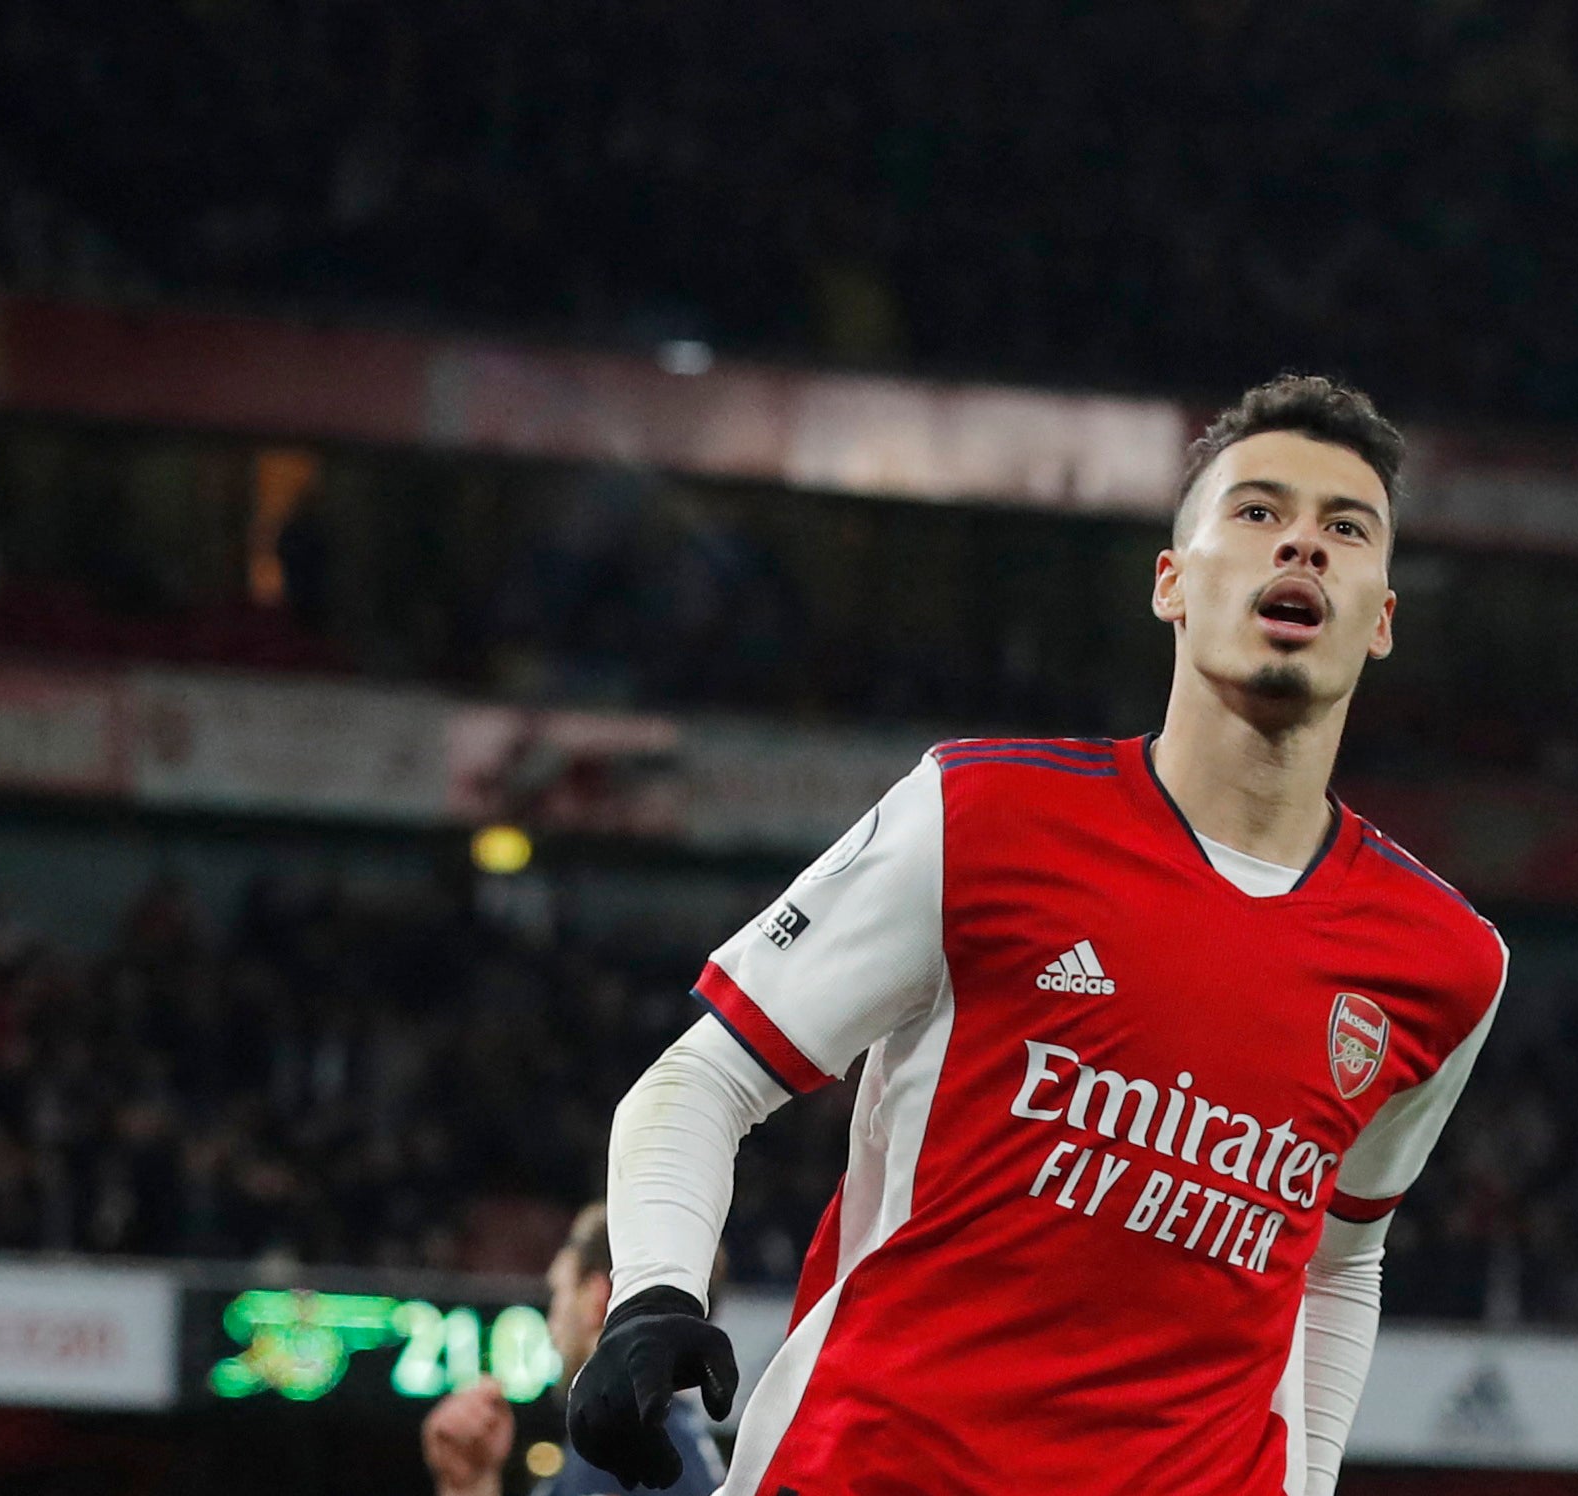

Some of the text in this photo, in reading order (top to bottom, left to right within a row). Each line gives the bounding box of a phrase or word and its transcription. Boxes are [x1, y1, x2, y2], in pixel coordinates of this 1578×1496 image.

[1035, 972, 1116, 996] adidas
[1339, 1006, 1382, 1041] Arsenal
[1010, 1039, 1338, 1209] Emirates
[1028, 1140, 1286, 1274] FLY BETTER
